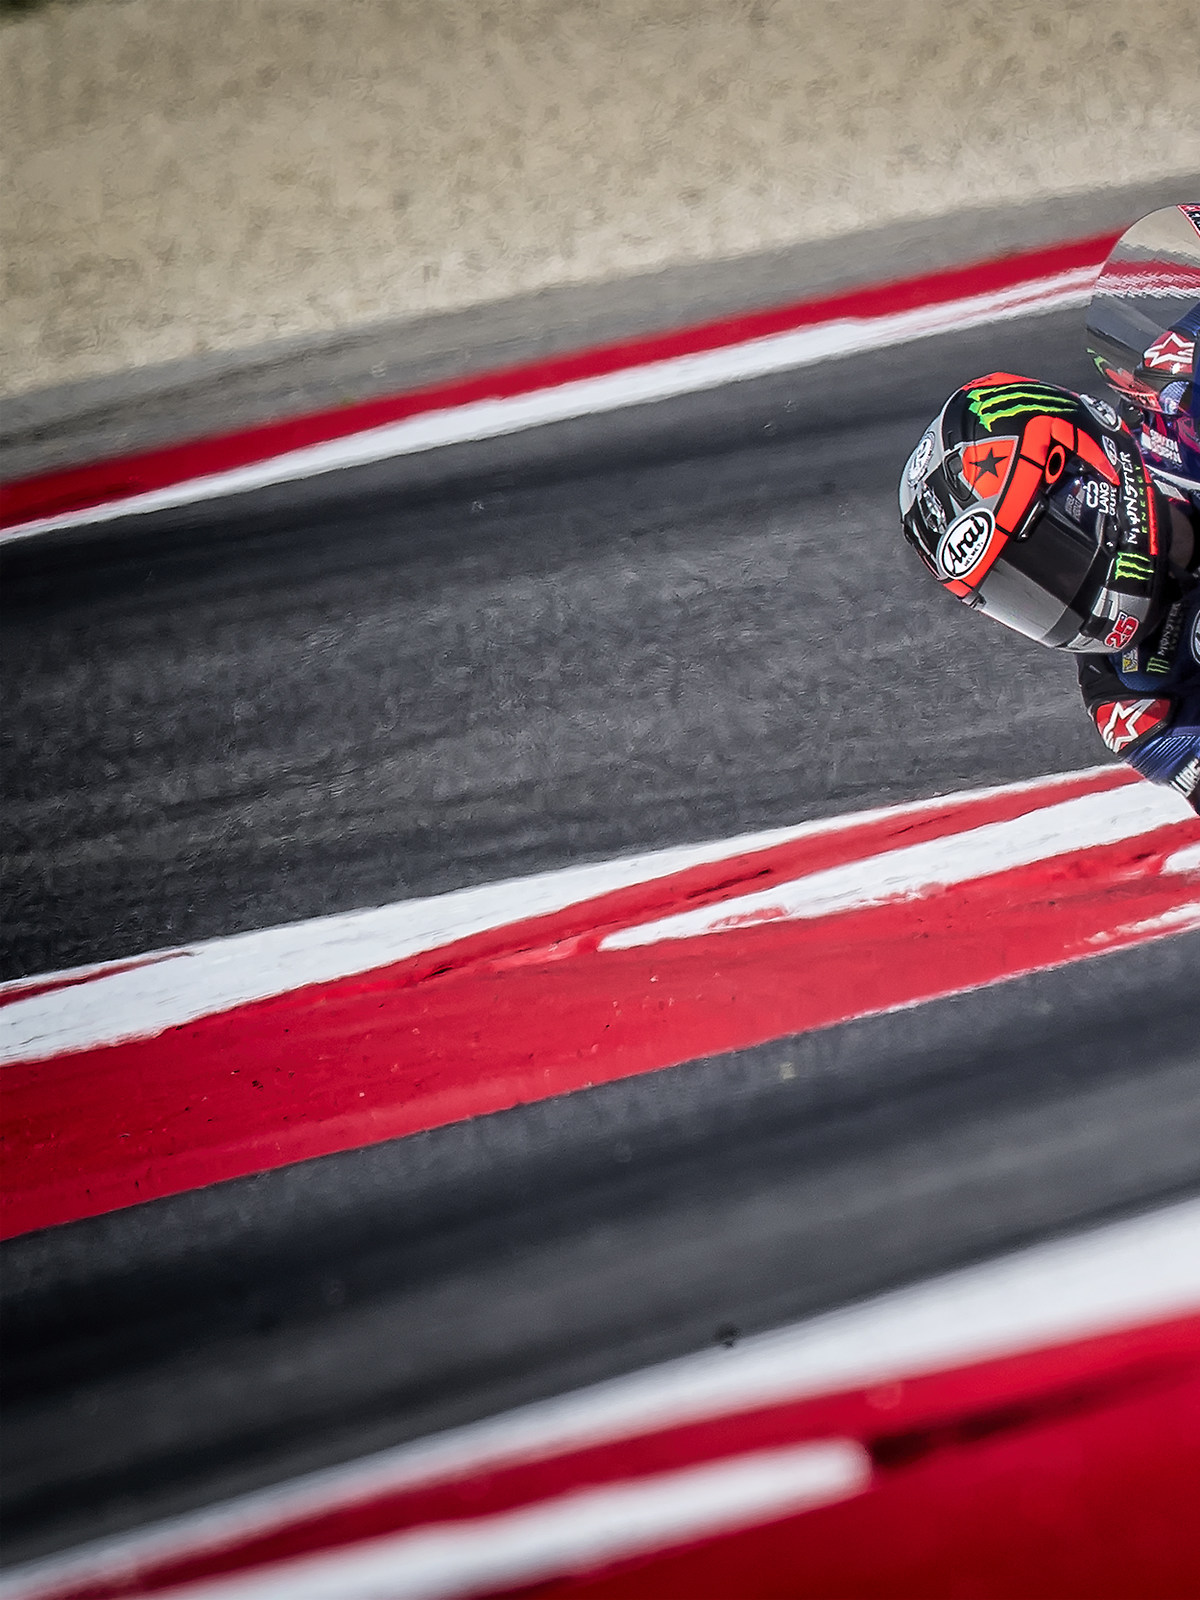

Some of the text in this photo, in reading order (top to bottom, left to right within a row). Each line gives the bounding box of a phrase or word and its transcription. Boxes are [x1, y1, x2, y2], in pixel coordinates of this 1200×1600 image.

[1120, 452, 1140, 545] MONSTER
[943, 516, 985, 575] Arai
[1104, 612, 1140, 650] 25
